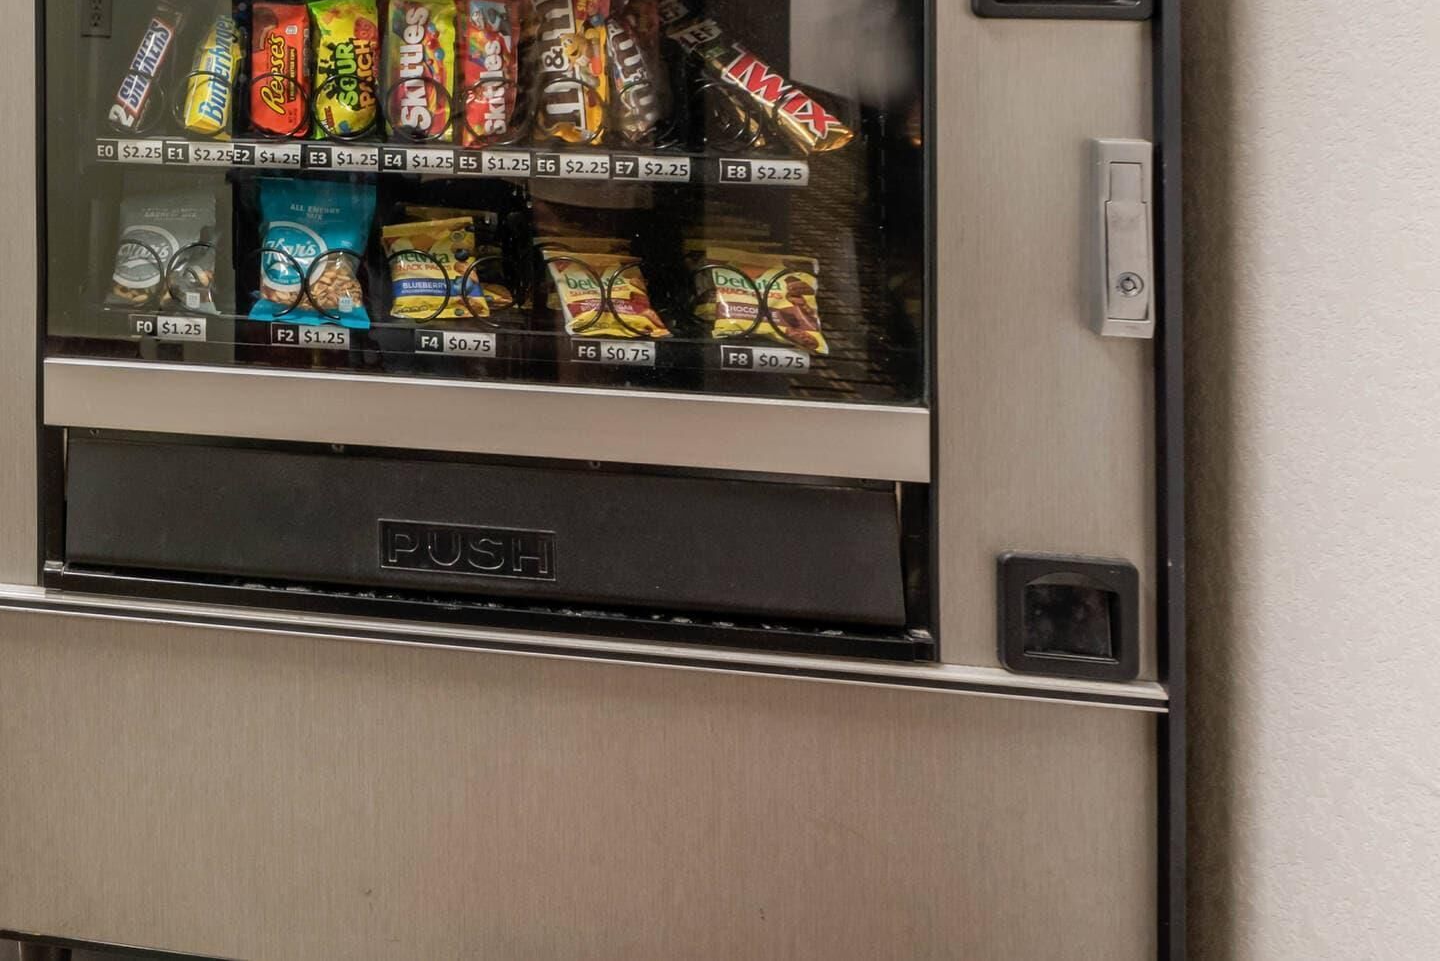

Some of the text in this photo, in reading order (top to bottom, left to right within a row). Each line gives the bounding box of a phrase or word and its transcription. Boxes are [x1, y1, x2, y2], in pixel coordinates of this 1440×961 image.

[261, 33, 286, 115] Reese's
[335, 43, 359, 107] SOUR
[722, 46, 842, 138] TWIX
[109, 104, 135, 127] 2
[97, 144, 162, 159] E0 $2.25
[167, 147, 234, 162] E1 $2.25
[233, 148, 300, 164] E2 $1.25
[310, 150, 378, 166] E3 $1.25
[384, 153, 454, 169] E4 $1.25
[460, 156, 530, 171] E5 $1.25
[537, 159, 609, 175] E6 $2.25
[615, 160, 688, 177] E7 $2.25
[727, 164, 802, 181] E8 $2.25
[136, 320, 202, 336] F0 $1.25
[277, 328, 345, 345] F2 $1.25
[421, 336, 491, 352] F4 $0.75
[578, 345, 650, 362] F6 $0.75
[728, 352, 805, 370] F8 $0.75
[387, 527, 549, 574] PUSH
